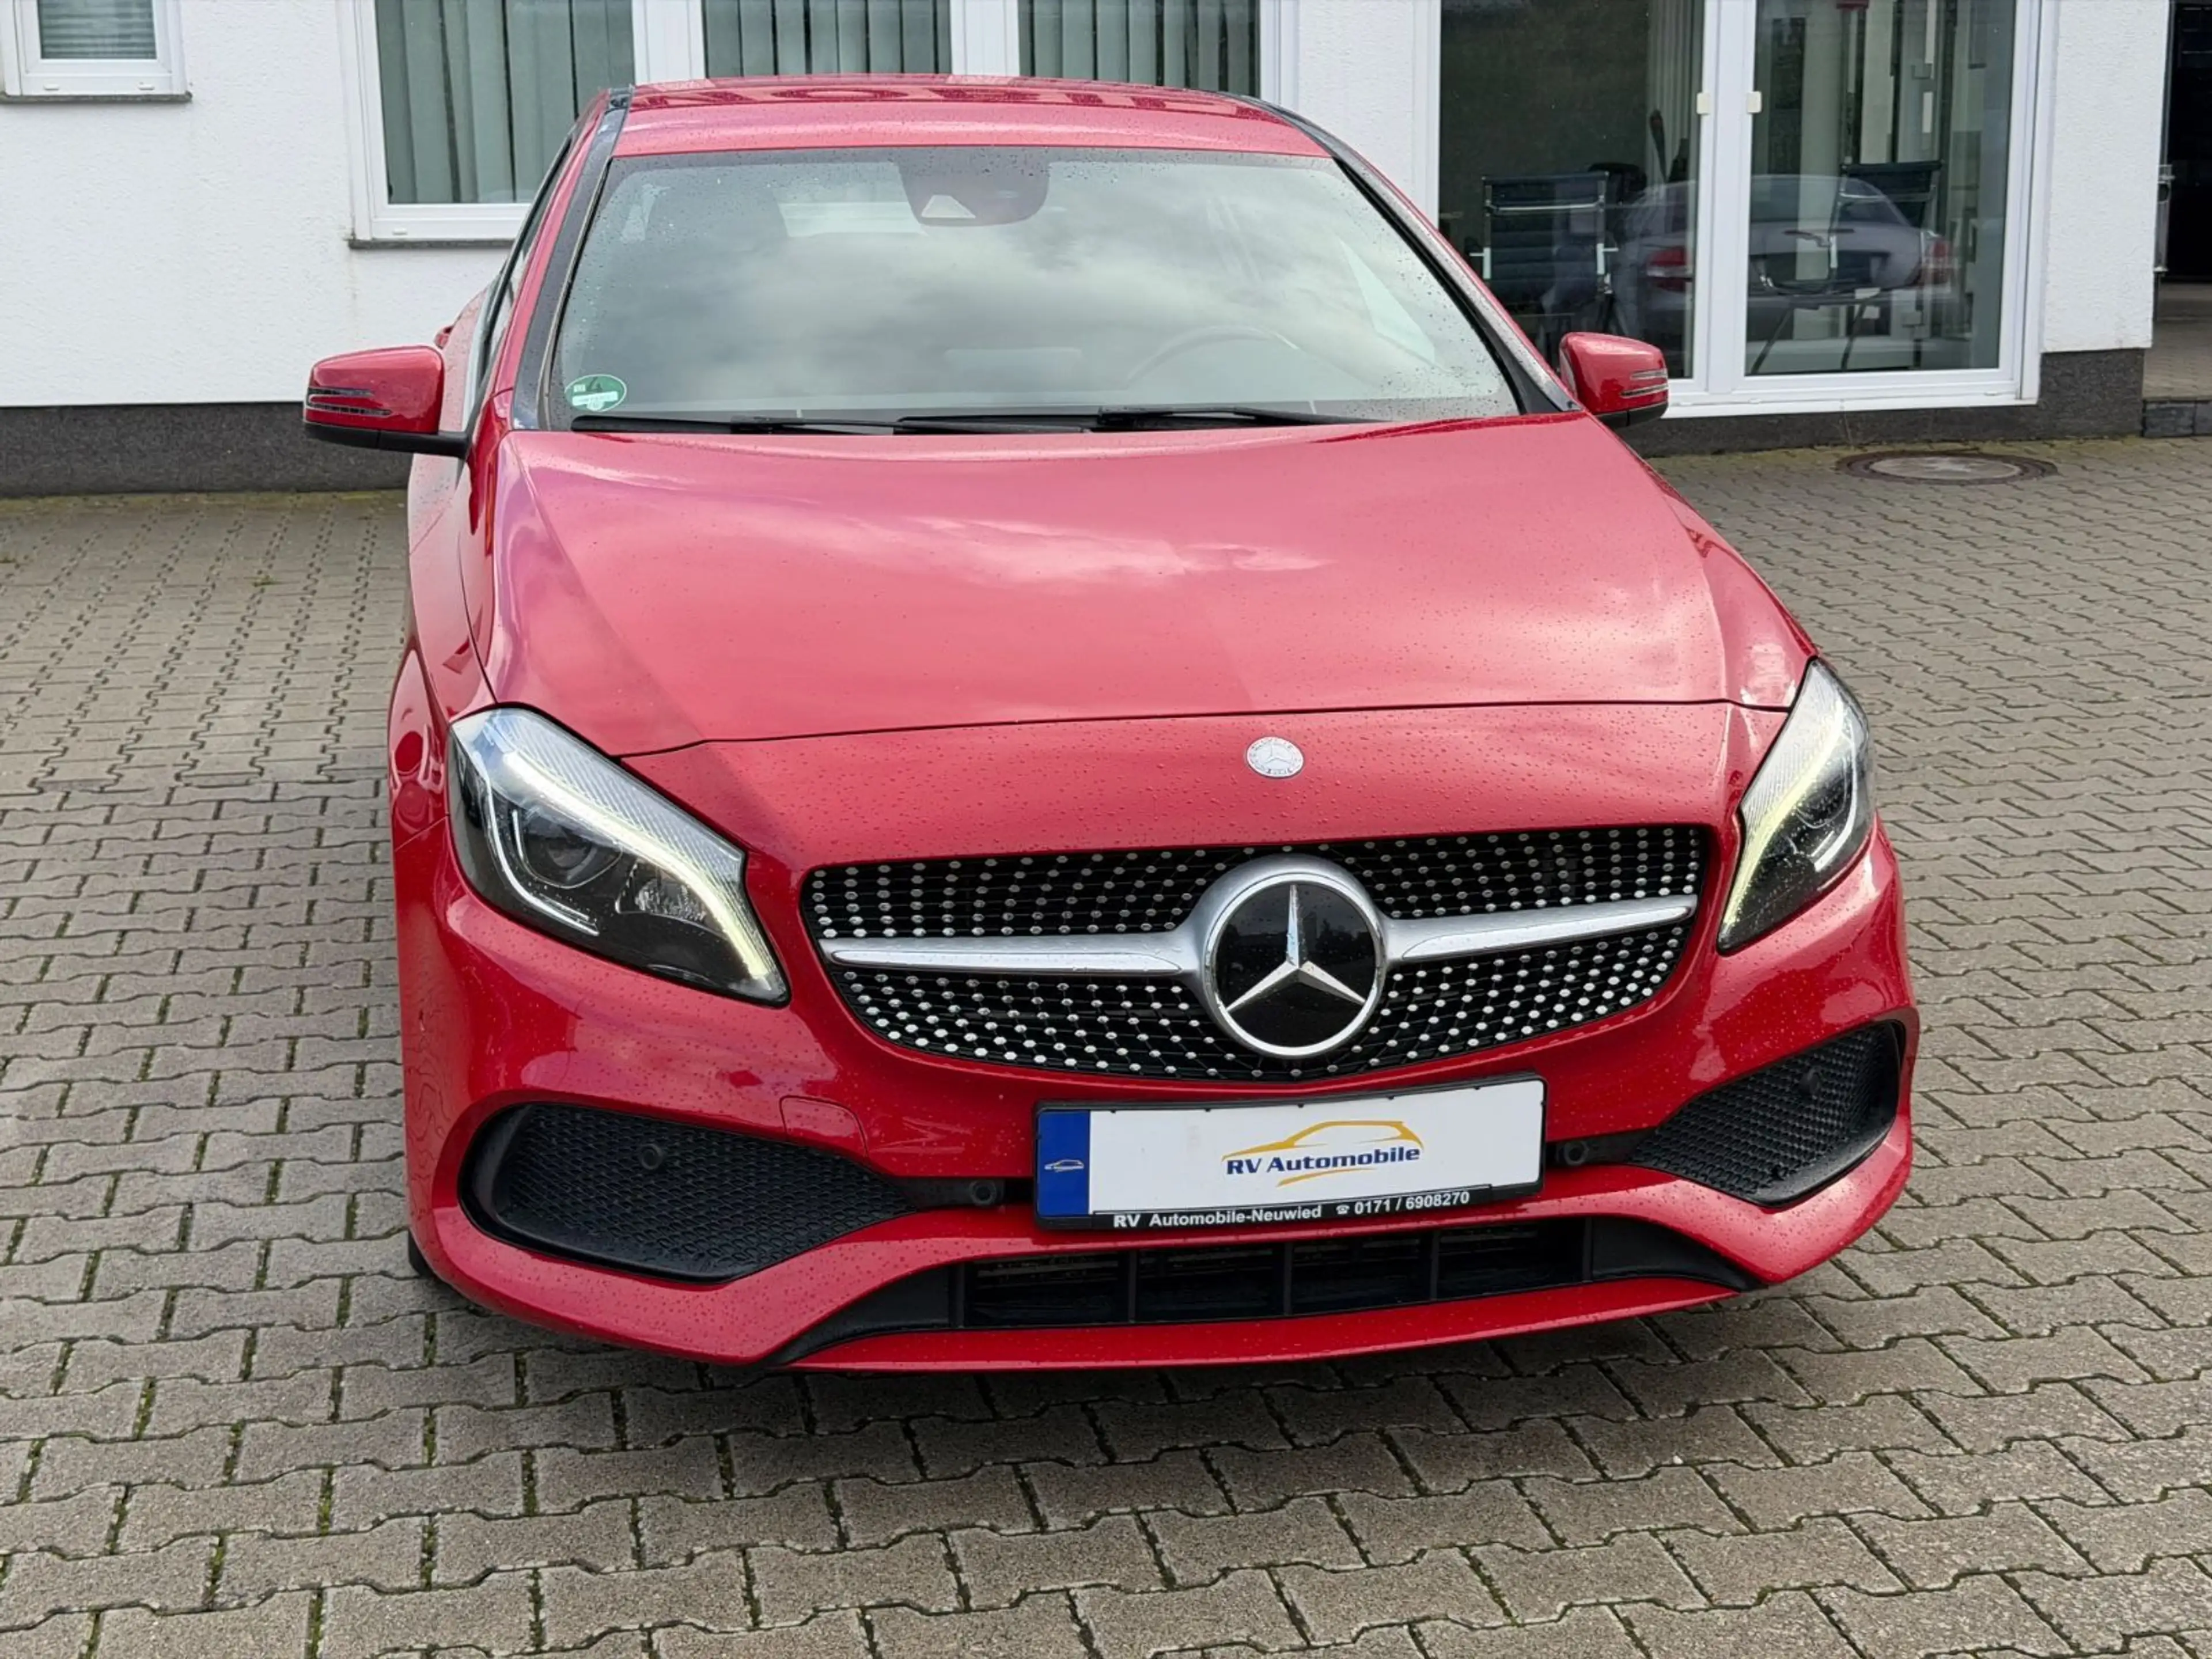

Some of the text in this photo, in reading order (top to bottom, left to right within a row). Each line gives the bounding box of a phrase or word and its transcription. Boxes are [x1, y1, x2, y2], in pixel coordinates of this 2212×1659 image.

[1227, 1147, 1420, 1175] RV Automobile
[1113, 1213, 1141, 1228] RV
[1149, 1205, 1322, 1226] Automobile-Neuwied
[1354, 1199, 1391, 1214] 0171
[1405, 1192, 1469, 1210] 6908270
